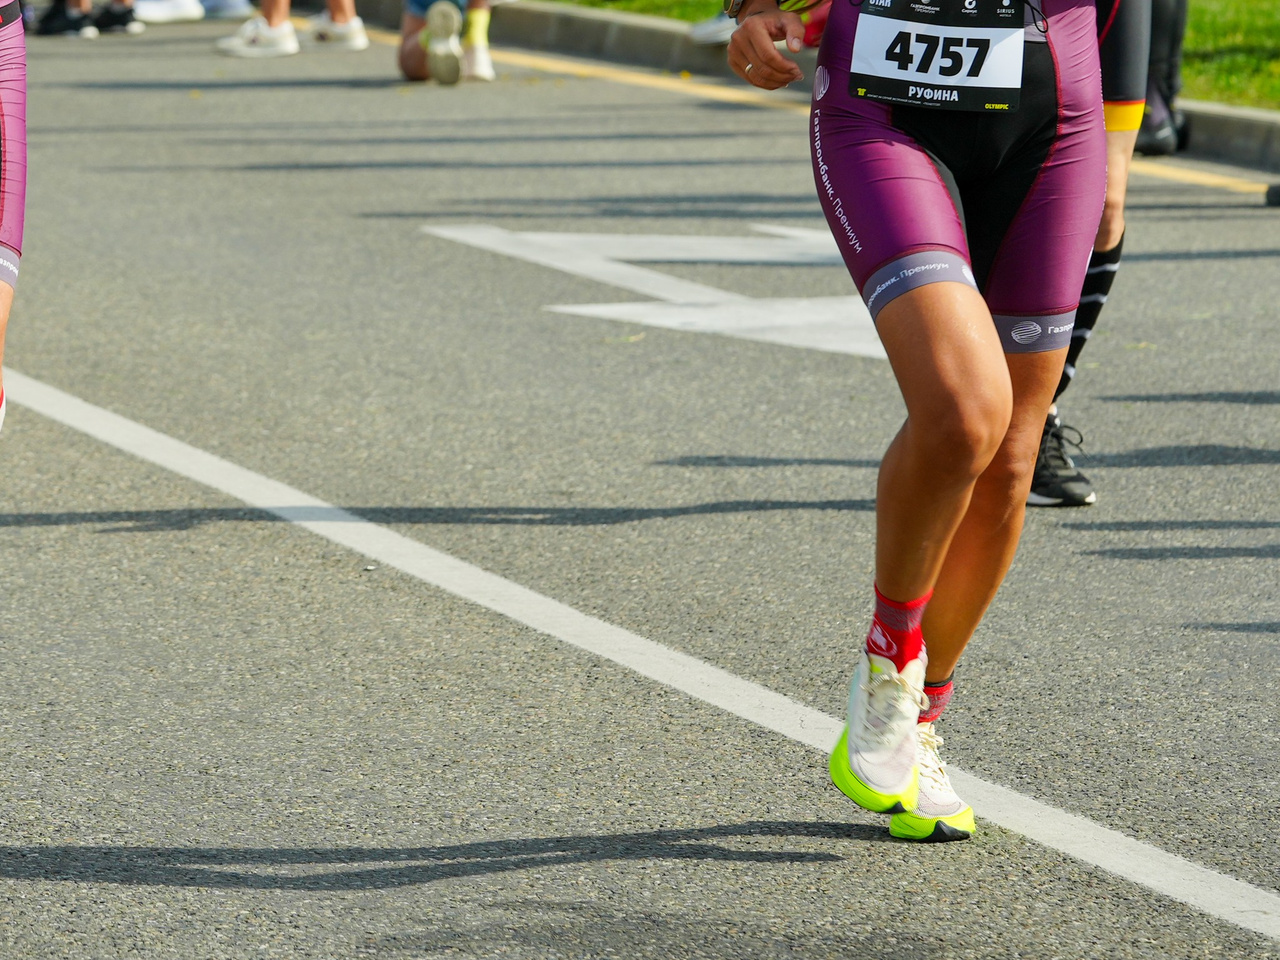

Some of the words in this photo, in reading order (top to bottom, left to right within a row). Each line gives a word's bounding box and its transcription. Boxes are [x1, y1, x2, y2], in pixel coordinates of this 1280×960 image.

[885, 30, 991, 78] 4757
[908, 85, 959, 102] РУФИНА
[832, 197, 863, 254] Премиум
[899, 262, 950, 279] Премиум
